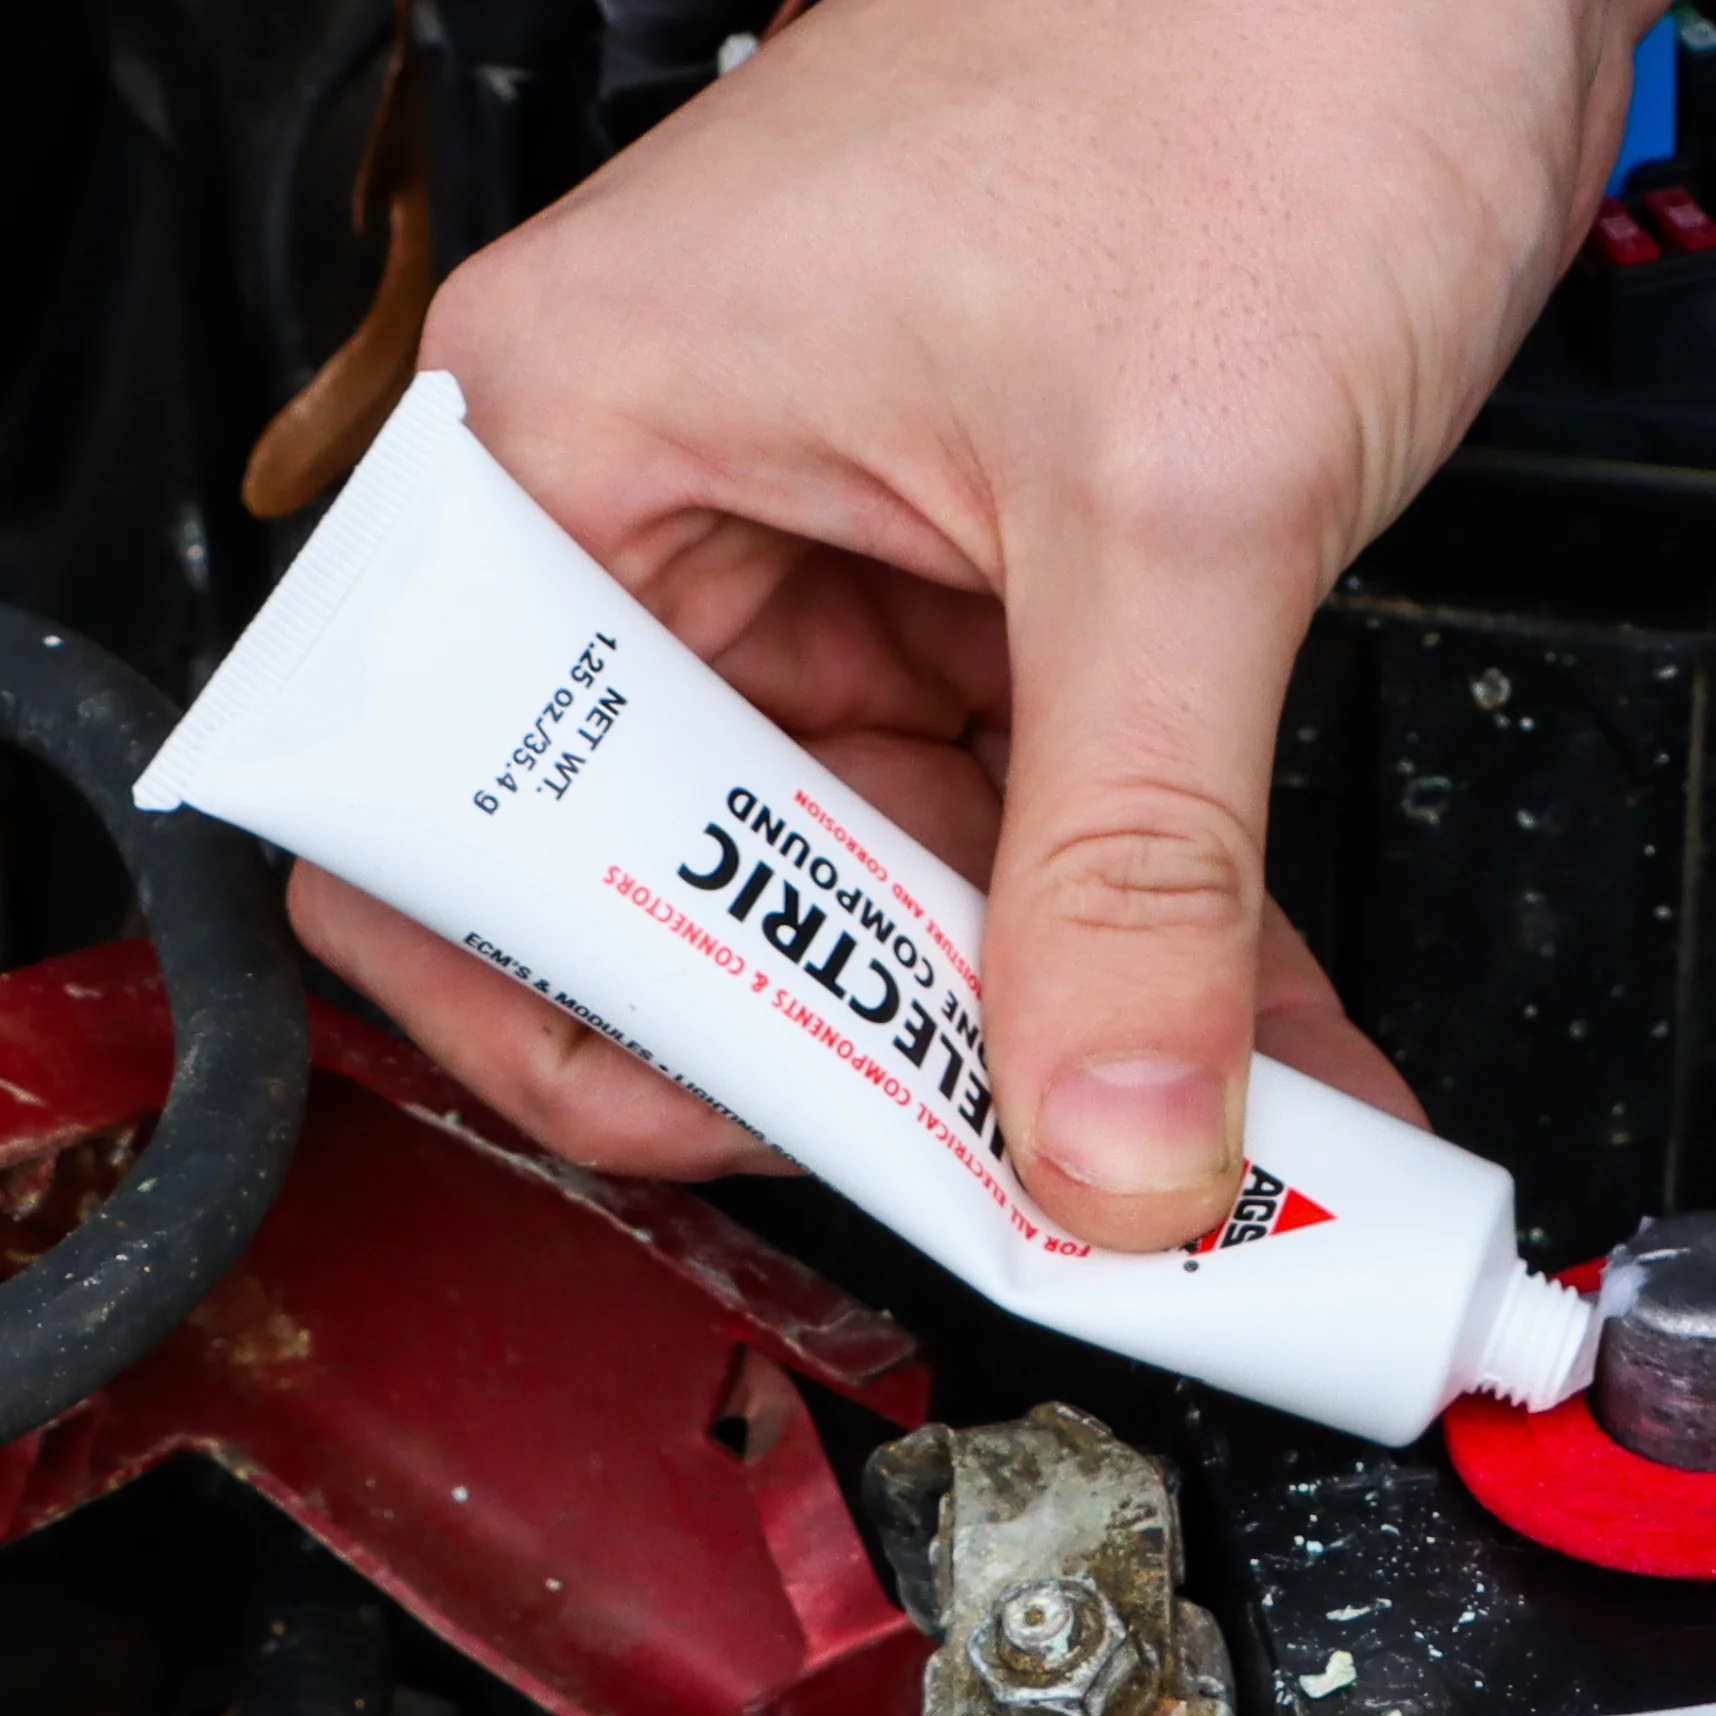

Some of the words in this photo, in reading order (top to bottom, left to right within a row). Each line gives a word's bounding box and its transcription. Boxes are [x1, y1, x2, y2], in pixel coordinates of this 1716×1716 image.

[570, 632, 616, 688] 1.25
[578, 687, 627, 751] NET
[473, 790, 499, 815] g
[537, 752, 586, 801] WT.
[794, 790, 888, 882] CORROSION
[727, 787, 934, 989] COMPOUND
[892, 883, 925, 919] AND
[603, 865, 746, 976] CONNECTORS
[532, 979, 550, 995] &
[752, 971, 769, 993] &
[772, 989, 911, 1107] COMPONENTS
[917, 1103, 1007, 1208] ELECTRICAL
[1011, 1207, 1039, 1240] ALL
[1220, 1165, 1284, 1249] AGS
[1043, 1235, 1095, 1258] FOR
